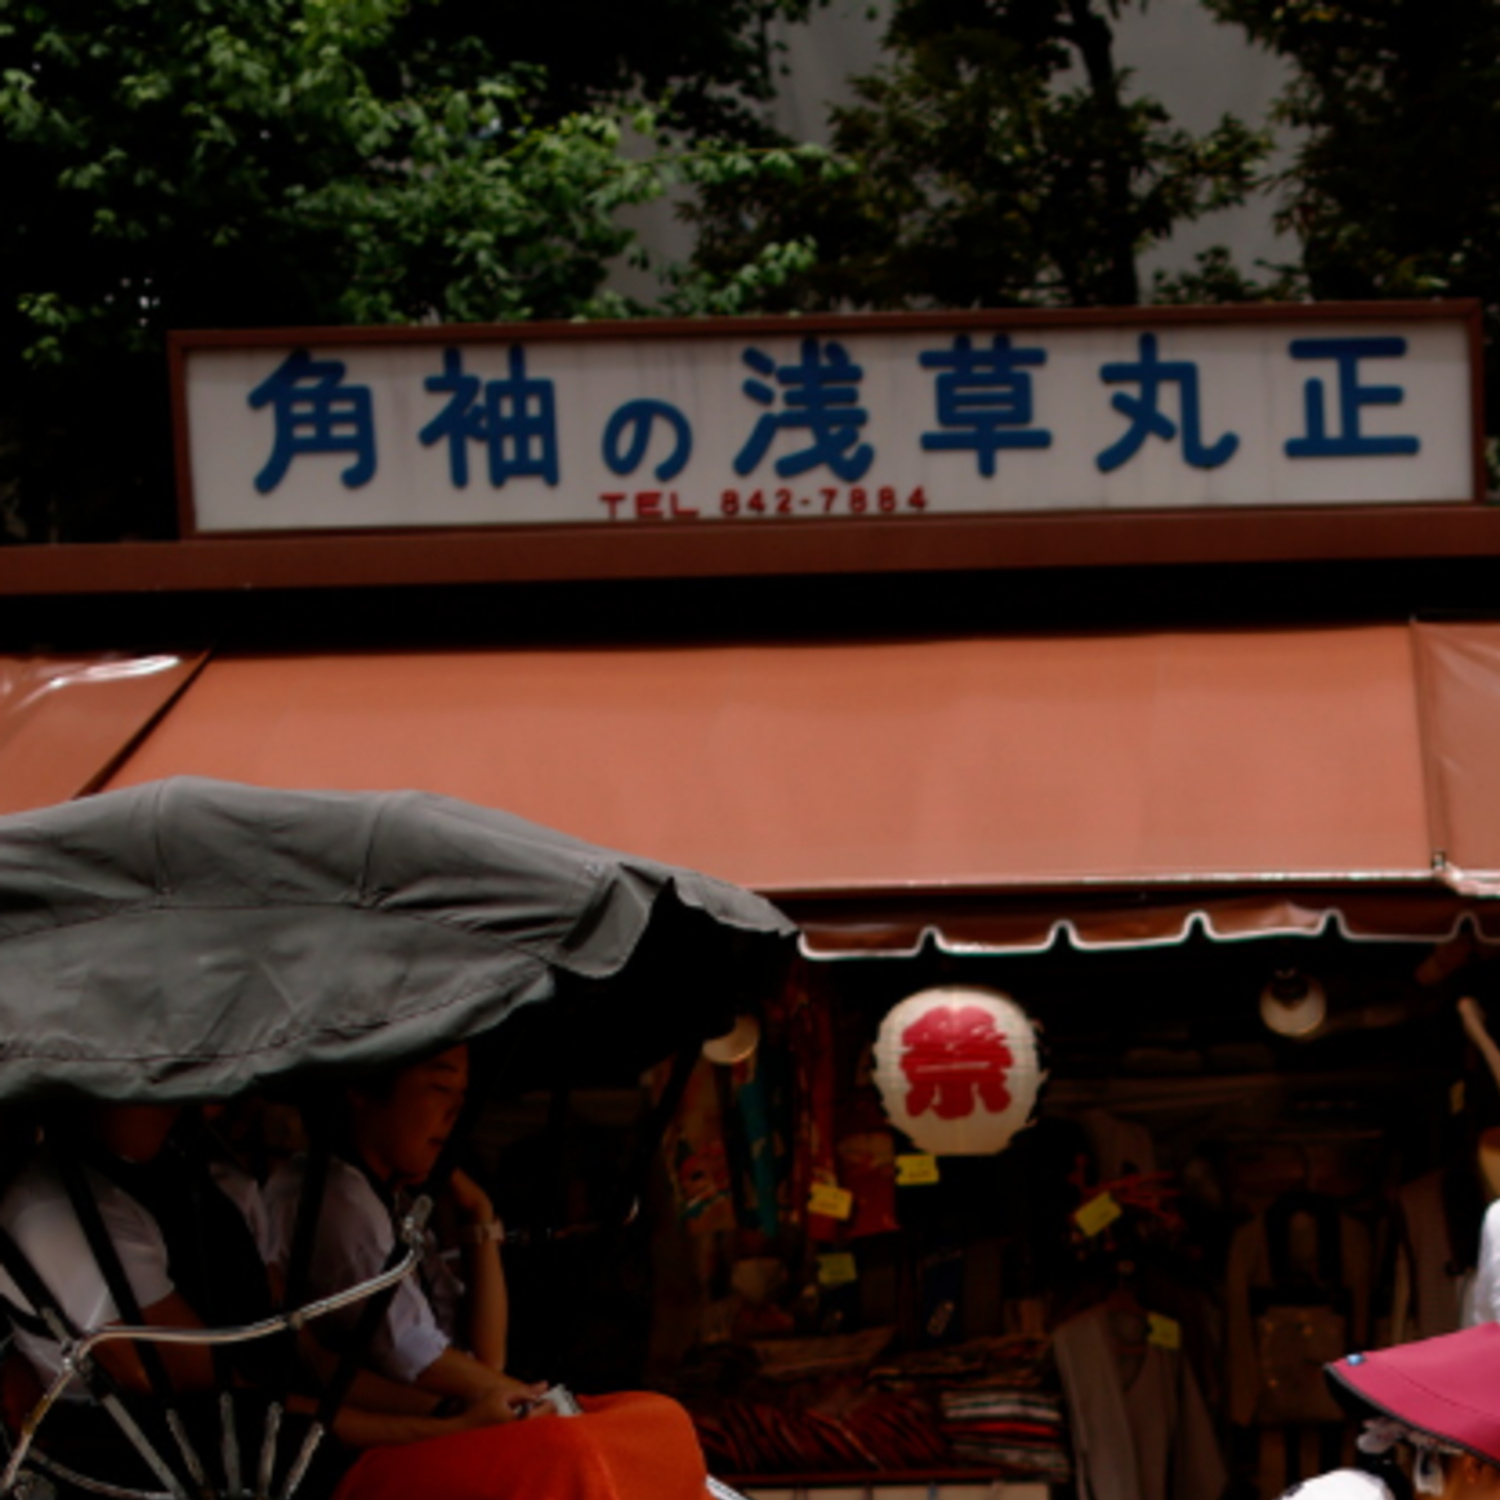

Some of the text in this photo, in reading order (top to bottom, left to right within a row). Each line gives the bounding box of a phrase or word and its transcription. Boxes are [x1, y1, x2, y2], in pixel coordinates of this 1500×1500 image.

[246, 332, 1421, 495] 角袖の浅草丸正
[599, 490, 700, 520] TEL
[900, 1005, 1014, 1121] 祭
